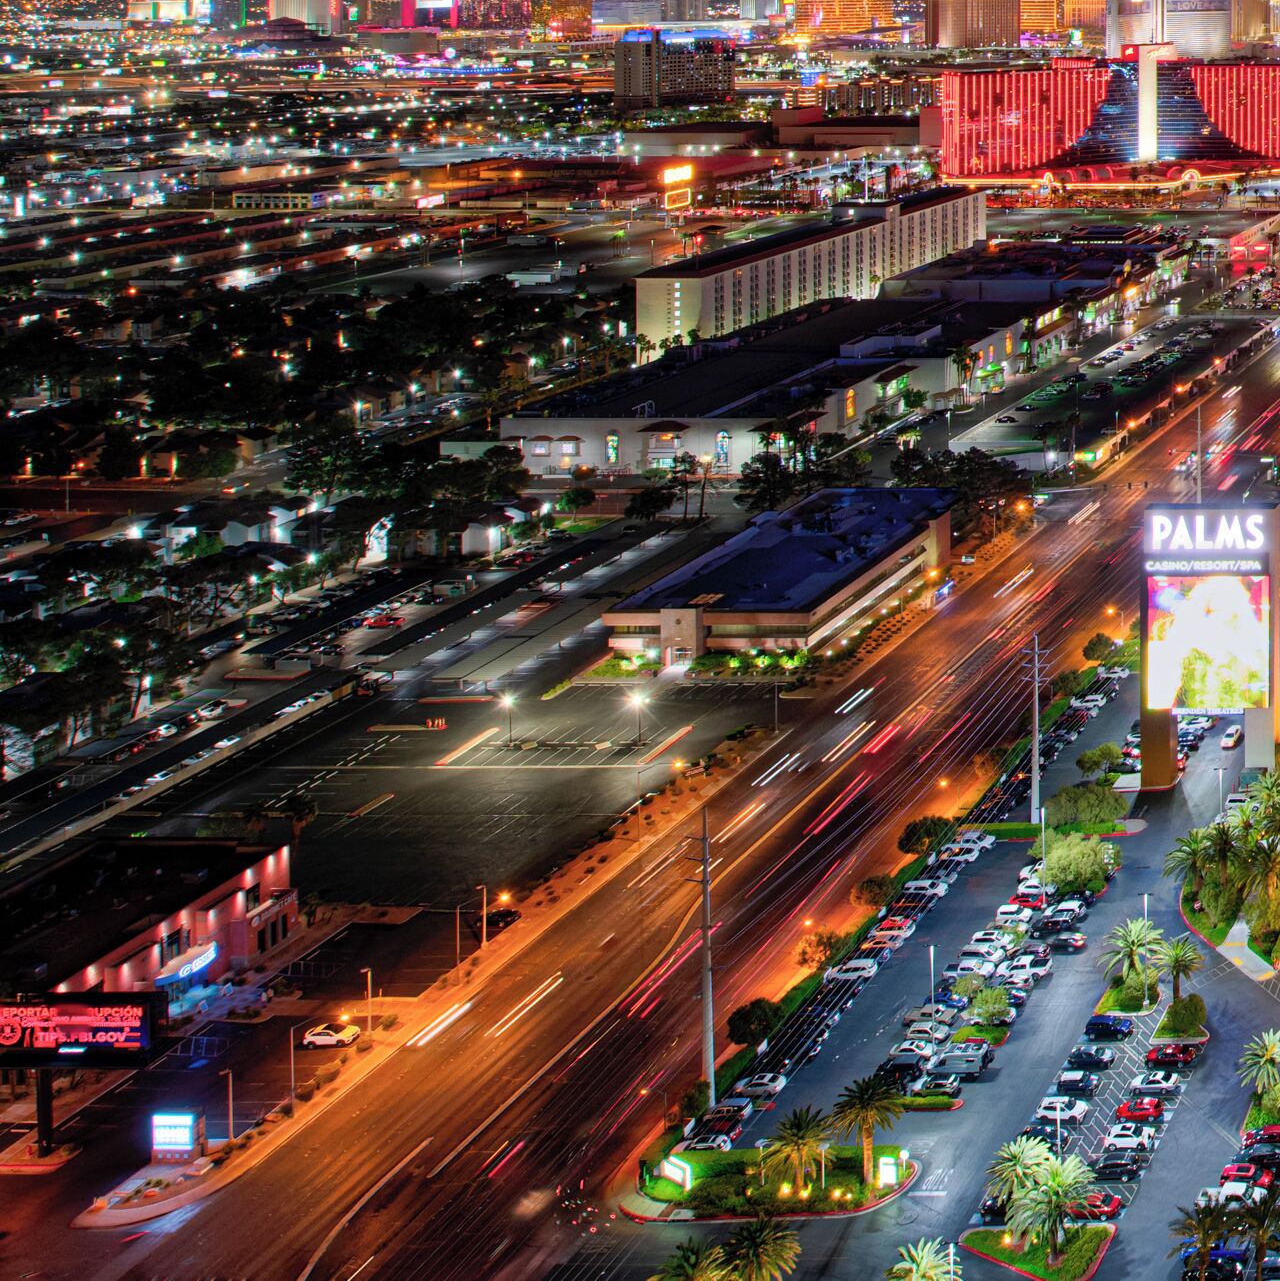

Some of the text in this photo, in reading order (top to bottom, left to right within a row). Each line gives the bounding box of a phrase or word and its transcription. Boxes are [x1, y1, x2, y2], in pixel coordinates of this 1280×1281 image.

[1177, 1, 1203, 10] LOVE
[1151, 514, 1265, 551] PALMS
[1145, 560, 1261, 572] CASINO/RESORT/SPA
[0, 1007, 58, 1017] EPORTAR
[39, 1032, 127, 1043] TIPS.FBI.GOV
